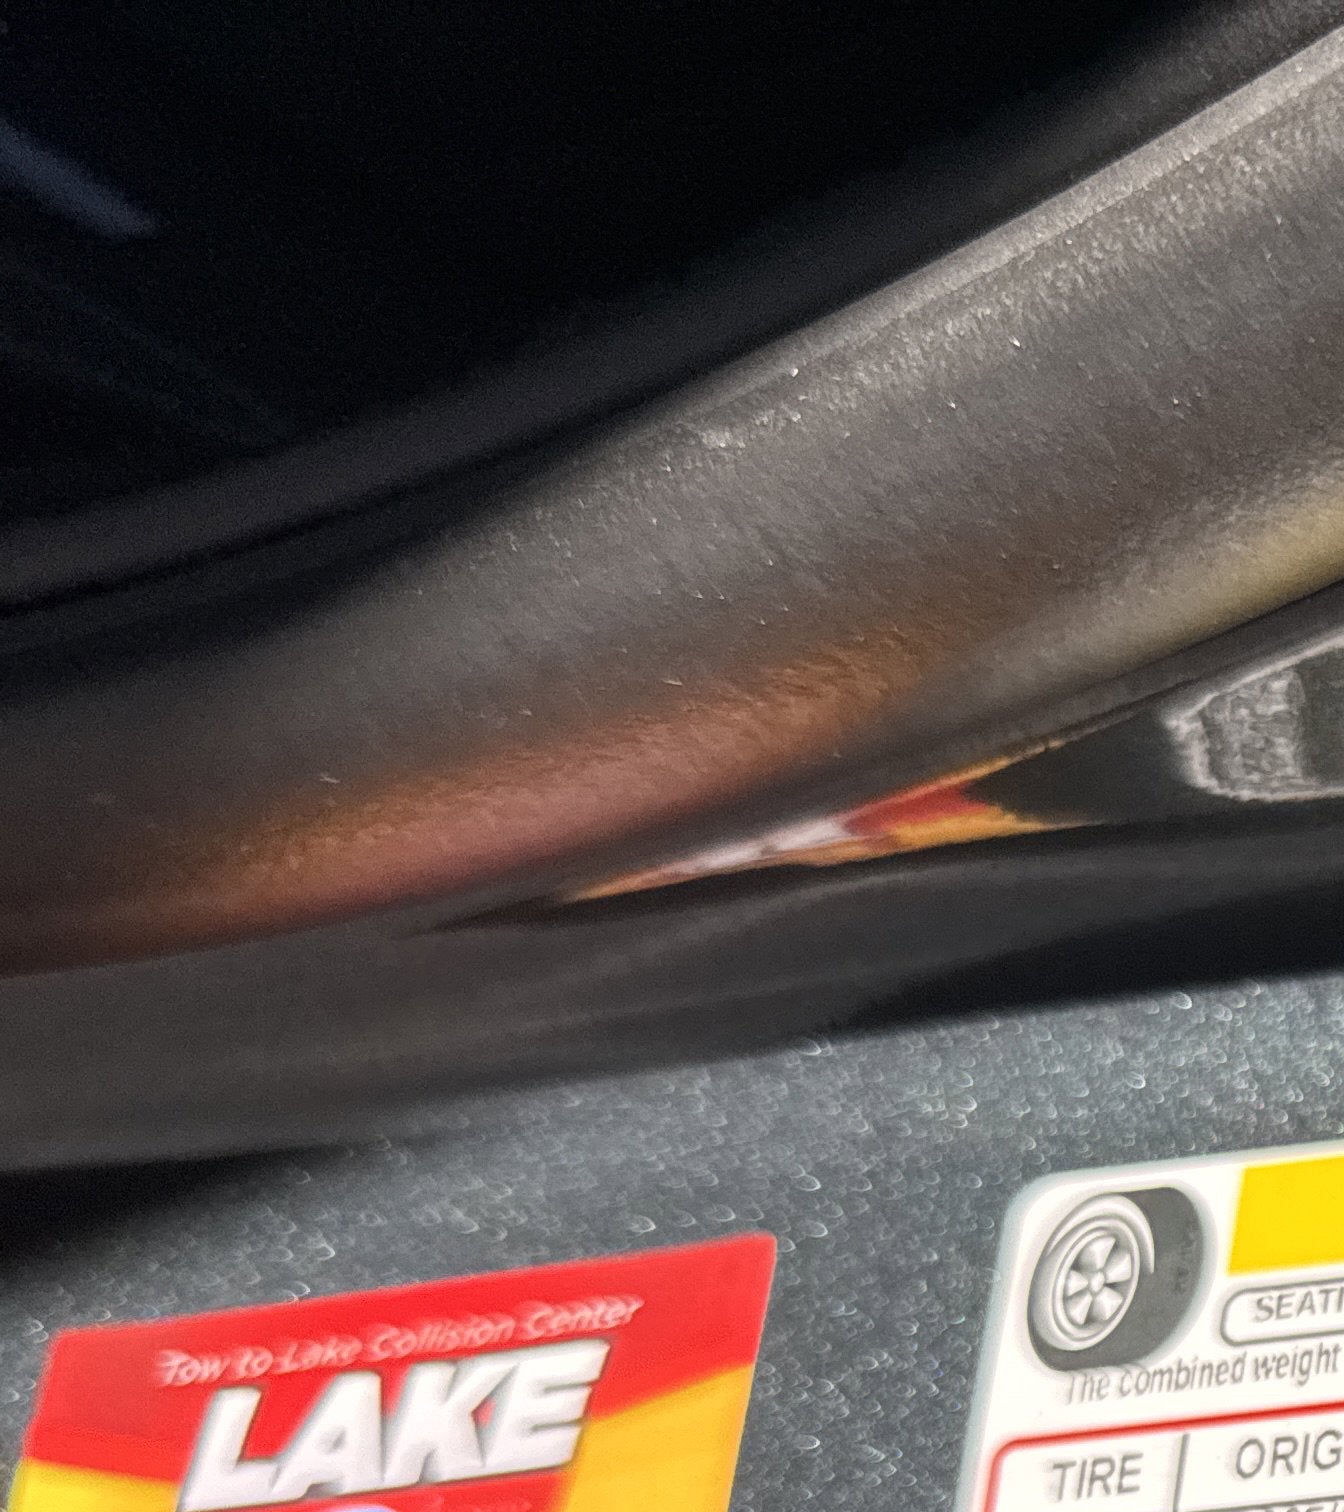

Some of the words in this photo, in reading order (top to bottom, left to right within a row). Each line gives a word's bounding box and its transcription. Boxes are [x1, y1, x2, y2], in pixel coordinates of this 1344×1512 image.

[158, 1348, 231, 1387] Tow
[237, 1347, 275, 1378] to
[276, 1337, 363, 1372] Lake
[368, 1313, 516, 1361] Collision
[516, 1294, 645, 1339] Center
[1067, 1370, 1110, 1405] The
[1118, 1352, 1248, 1397] combined
[1254, 1341, 1342, 1388] weight
[1052, 1453, 1143, 1502] TIRE
